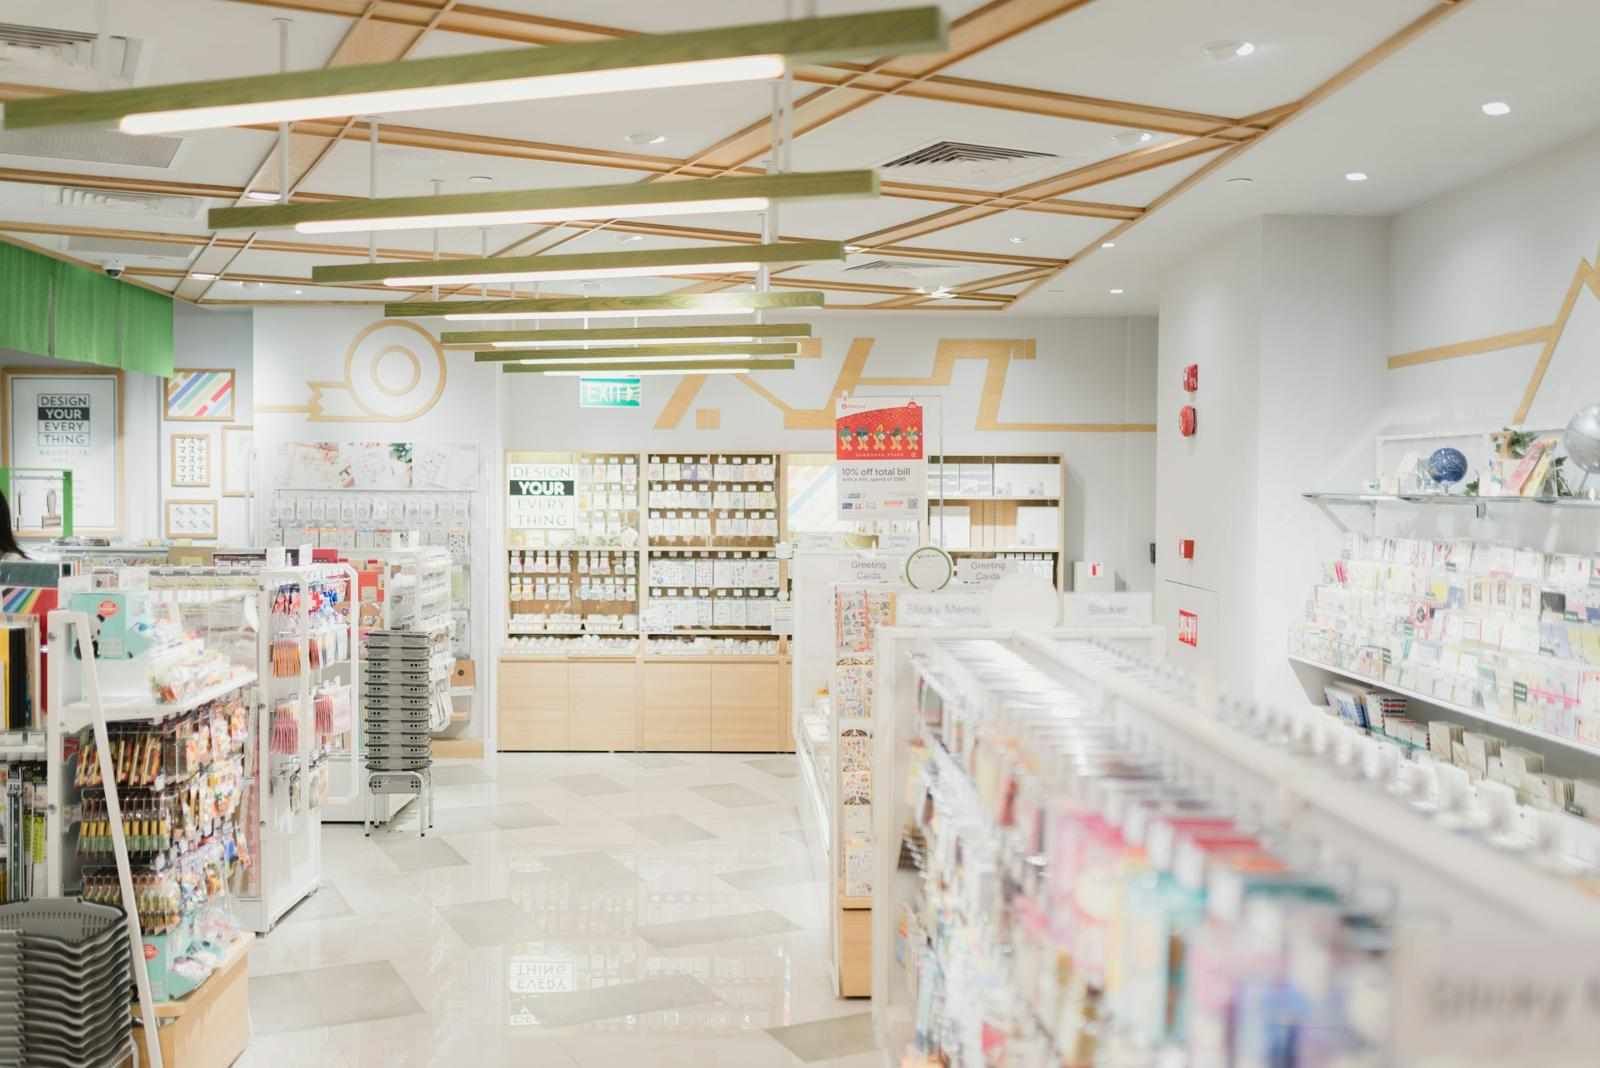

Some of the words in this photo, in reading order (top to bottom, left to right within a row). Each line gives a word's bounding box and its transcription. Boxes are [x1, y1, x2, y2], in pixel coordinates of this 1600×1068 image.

[587, 384, 625, 402] EXIT
[41, 396, 88, 406] DESIGN
[46, 408, 82, 419] YOUR
[45, 422, 85, 431] EVERY
[45, 434, 86, 443] THING
[513, 466, 570, 478] DESIGN
[842, 467, 859, 476] 10%
[861, 467, 873, 476] off
[875, 467, 895, 476] total
[897, 467, 911, 476] bill
[518, 481, 565, 496] YOUR
[517, 498, 567, 510] EVERY
[514, 513, 568, 526] THING
[851, 560, 888, 571] Greeting
[970, 561, 1007, 571] Greeting
